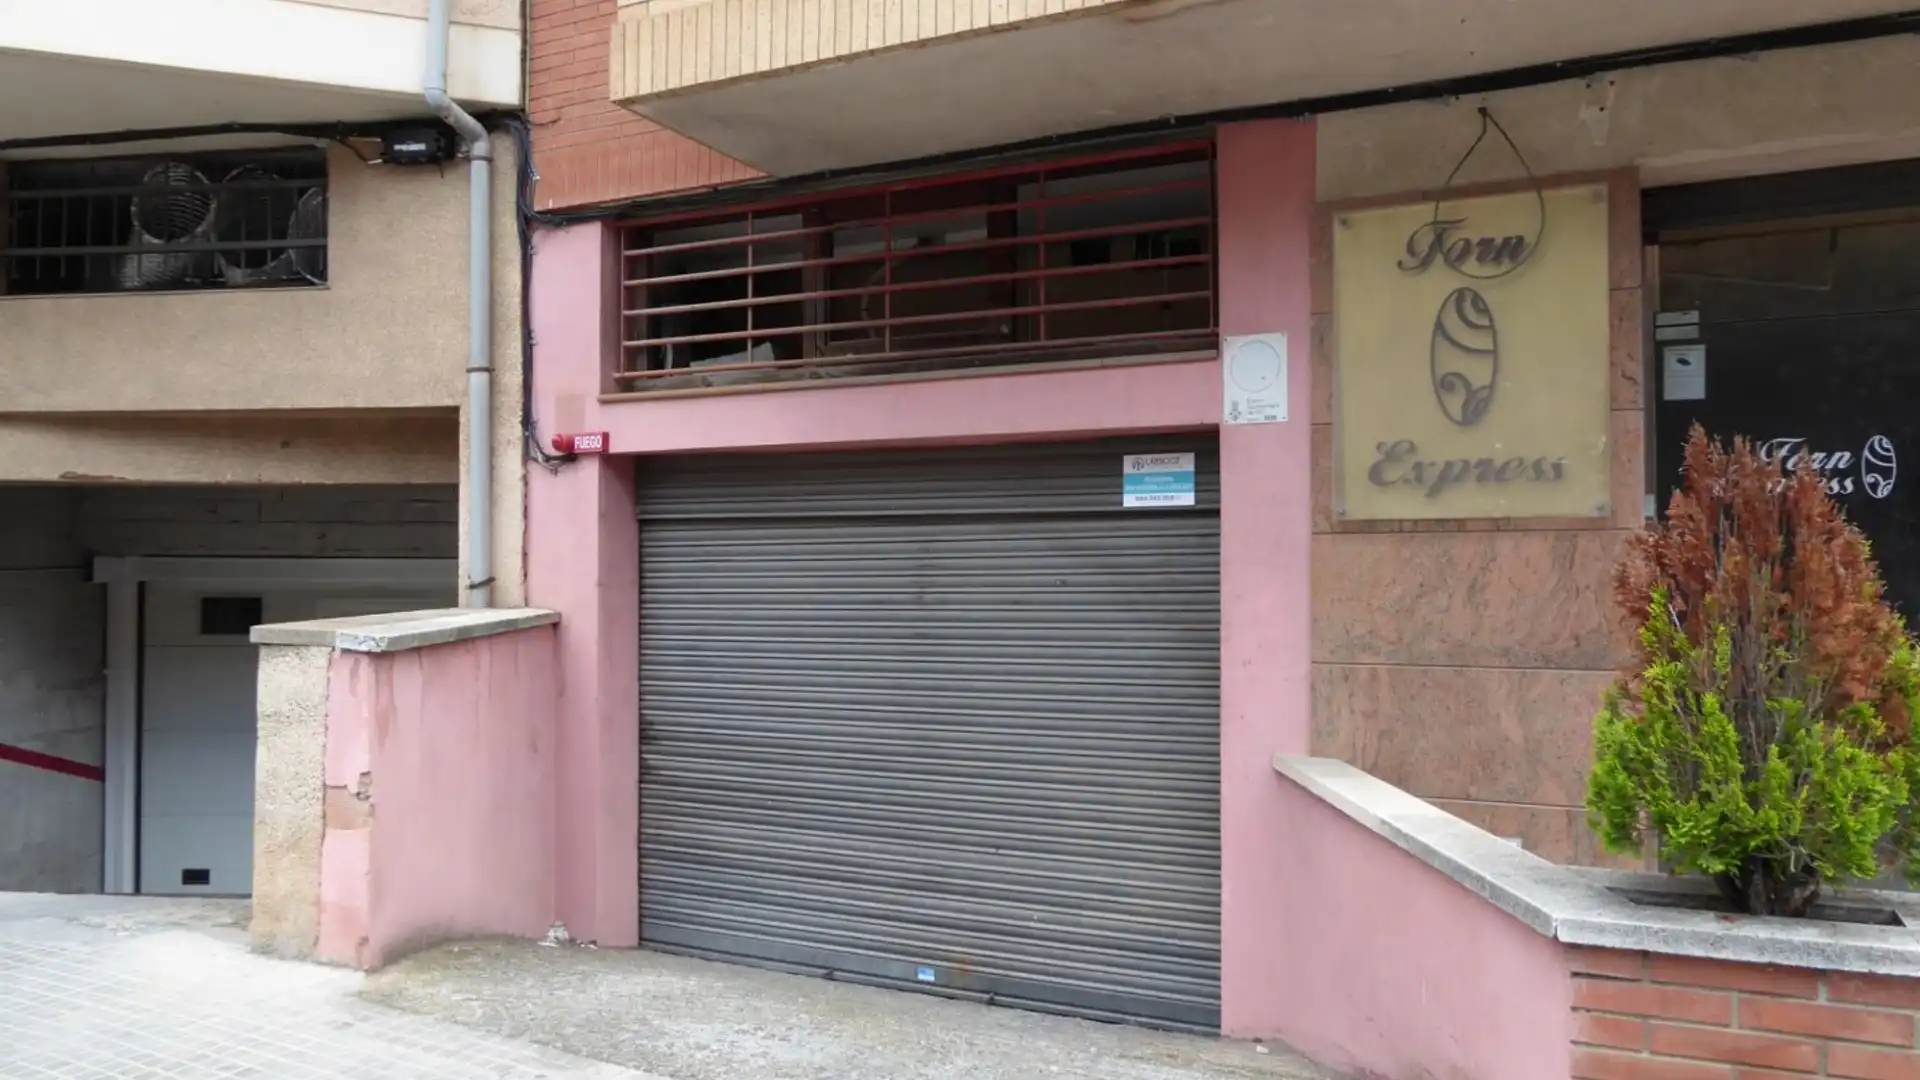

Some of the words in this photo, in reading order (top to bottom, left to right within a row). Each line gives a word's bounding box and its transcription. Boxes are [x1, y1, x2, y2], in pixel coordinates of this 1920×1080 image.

[1396, 216, 1528, 273] Forn
[574, 435, 602, 449] FUEGO
[1368, 438, 1565, 498] Express
